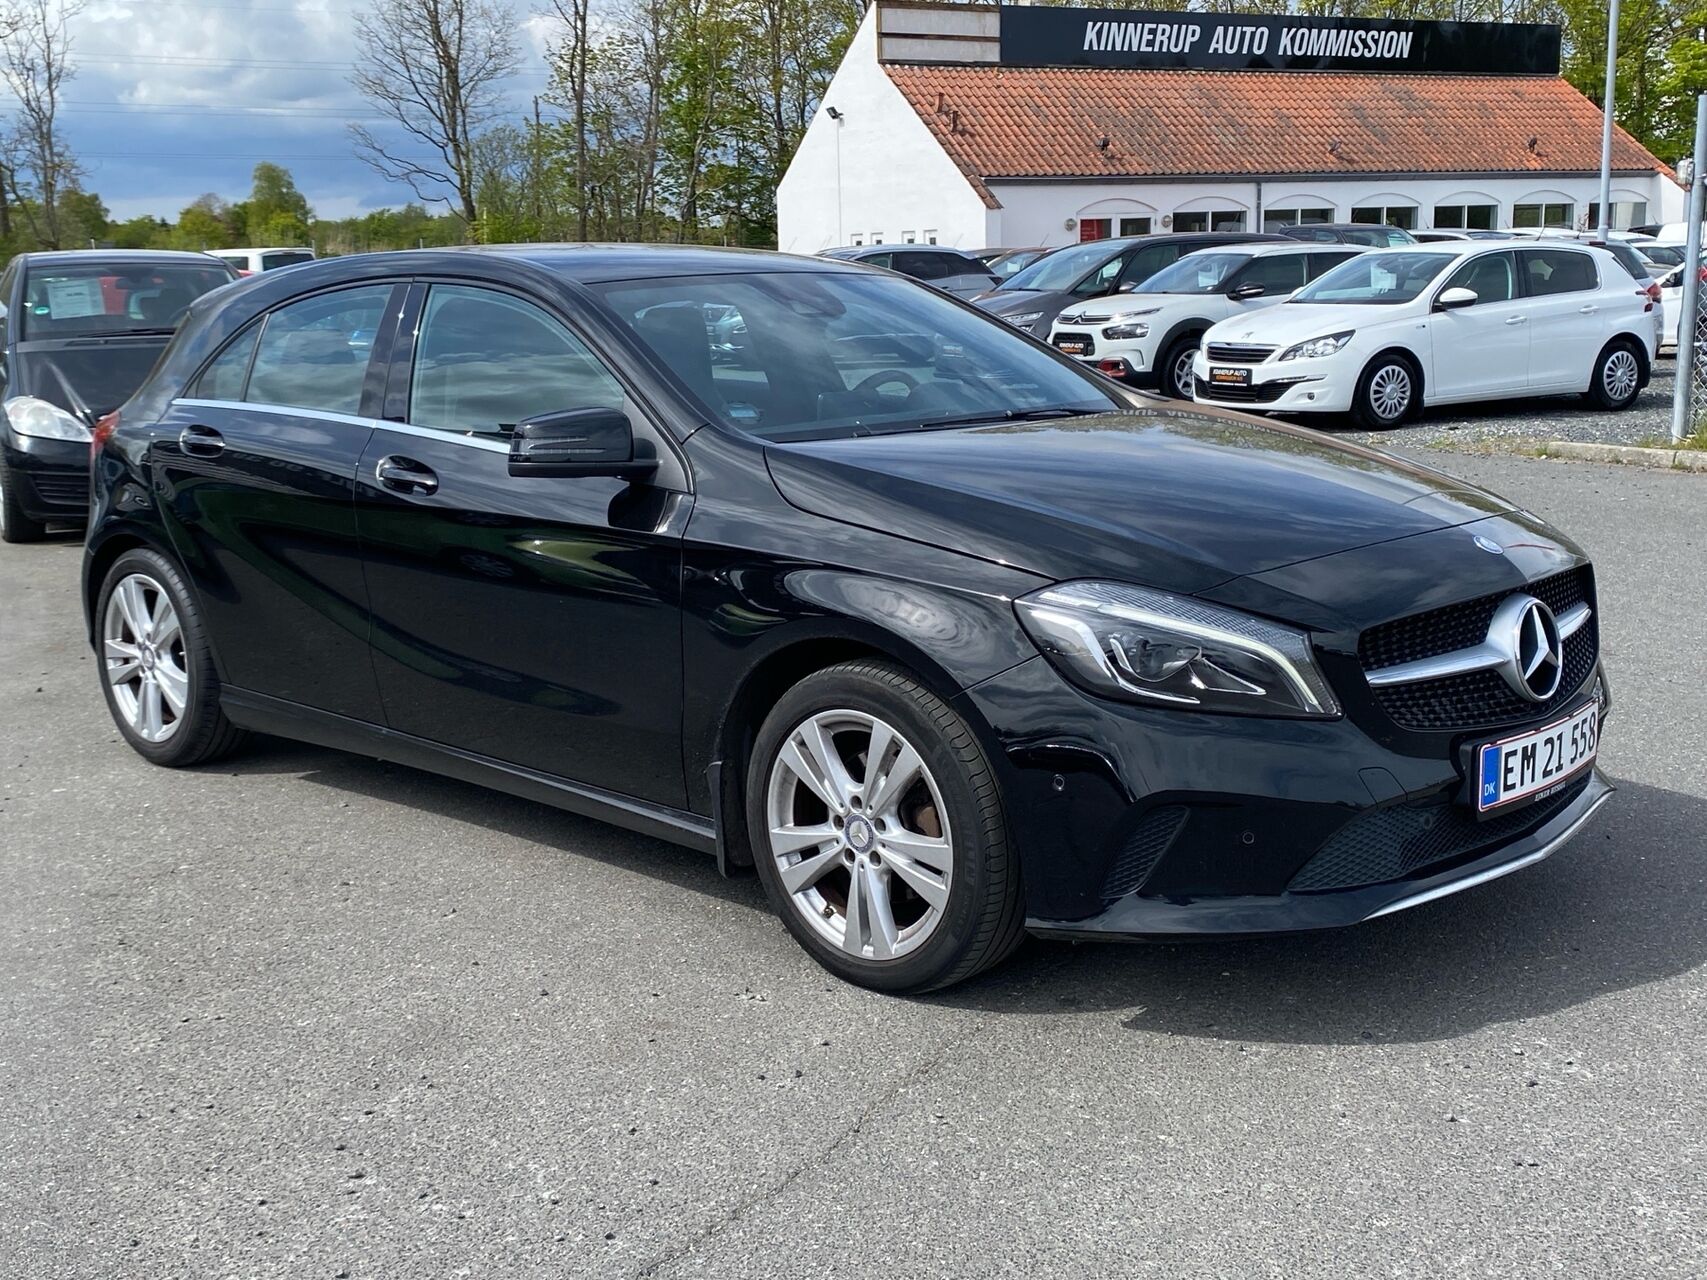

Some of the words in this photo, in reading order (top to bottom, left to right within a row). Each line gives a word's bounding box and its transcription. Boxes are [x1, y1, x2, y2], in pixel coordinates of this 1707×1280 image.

[1084, 21, 1201, 54] KINNERUP
[1208, 25, 1270, 56] AUTO
[1278, 27, 1414, 59] KOMMISSION
[1503, 742, 1538, 792] EM
[1542, 731, 1564, 779] 21
[1570, 711, 1596, 765] 558
[1484, 781, 1496, 797] DK
